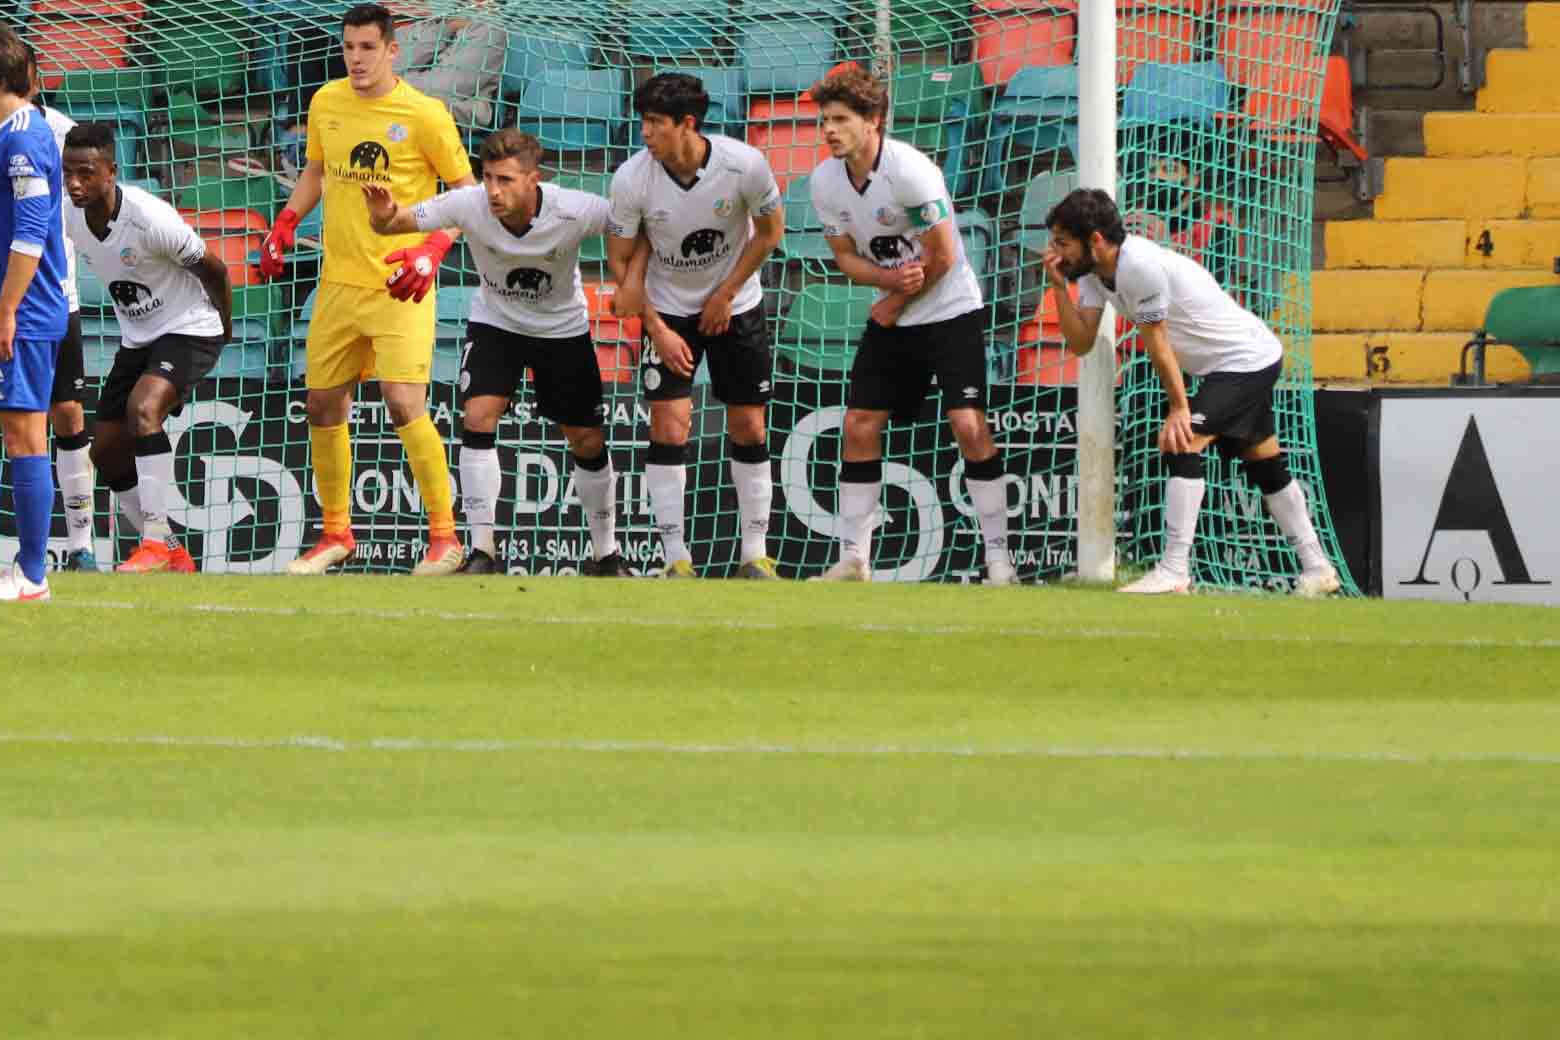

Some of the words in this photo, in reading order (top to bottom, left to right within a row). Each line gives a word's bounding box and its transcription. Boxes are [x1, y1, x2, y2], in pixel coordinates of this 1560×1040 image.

[987, 411, 1080, 434] HOSTA
[1399, 413, 1552, 586] A
[546, 538, 666, 561] SALAANCA
